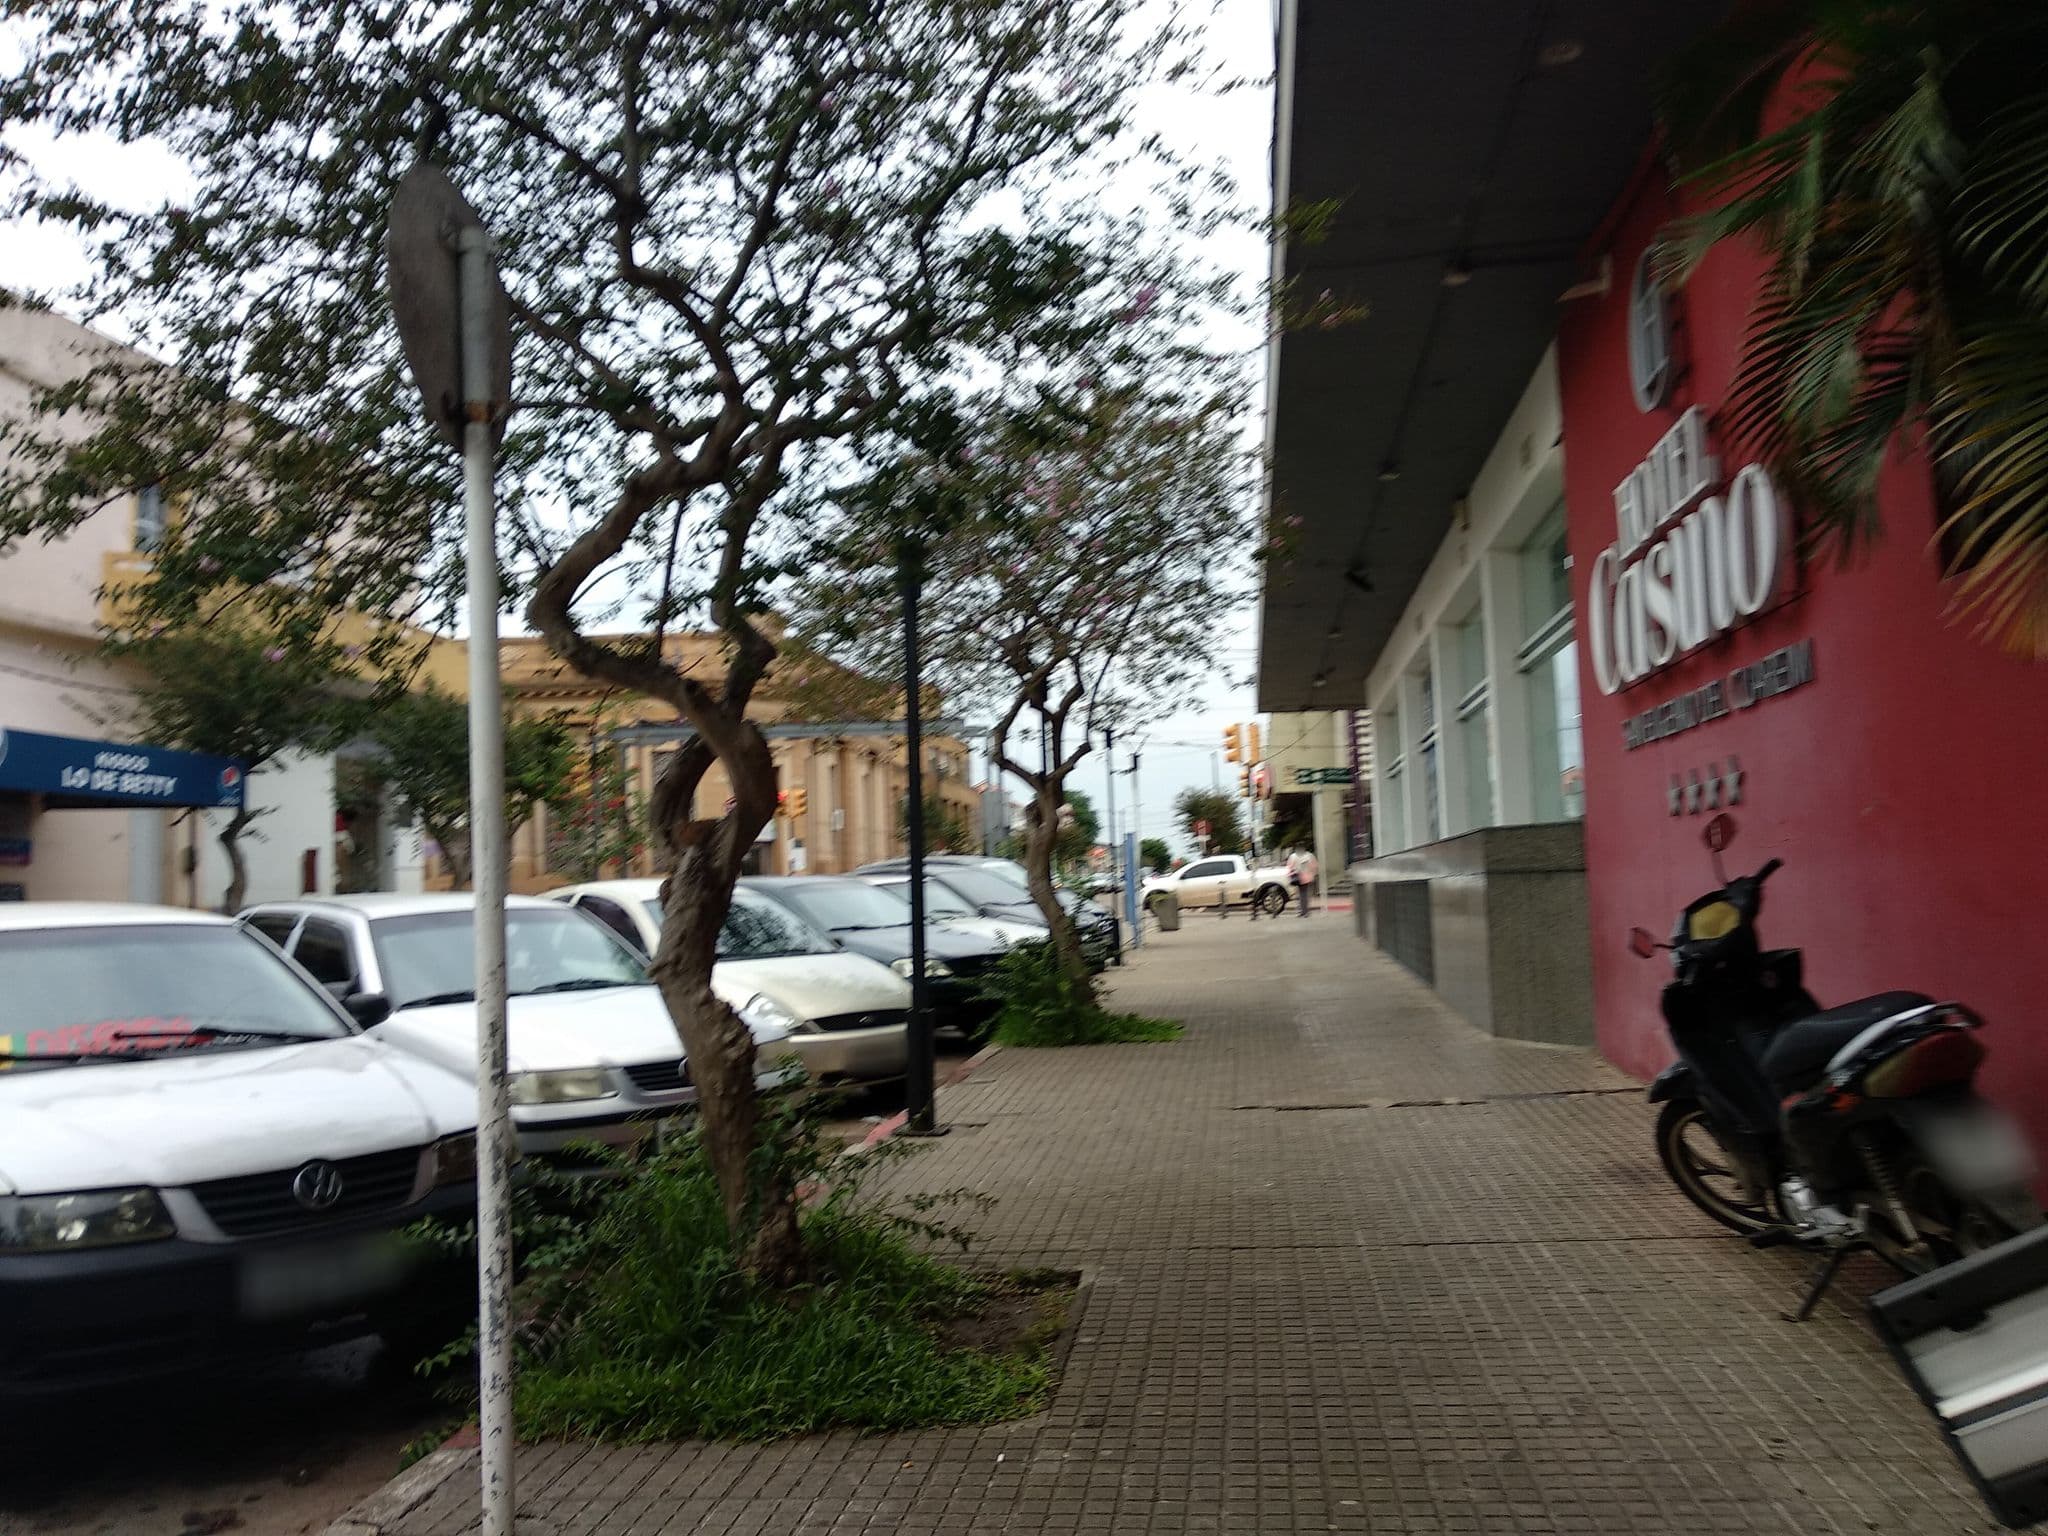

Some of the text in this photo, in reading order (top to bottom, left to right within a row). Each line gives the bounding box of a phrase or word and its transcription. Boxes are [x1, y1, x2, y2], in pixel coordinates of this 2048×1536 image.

[1612, 404, 1718, 560] HOTEL
[61, 766, 178, 797] LO DE BETTY
